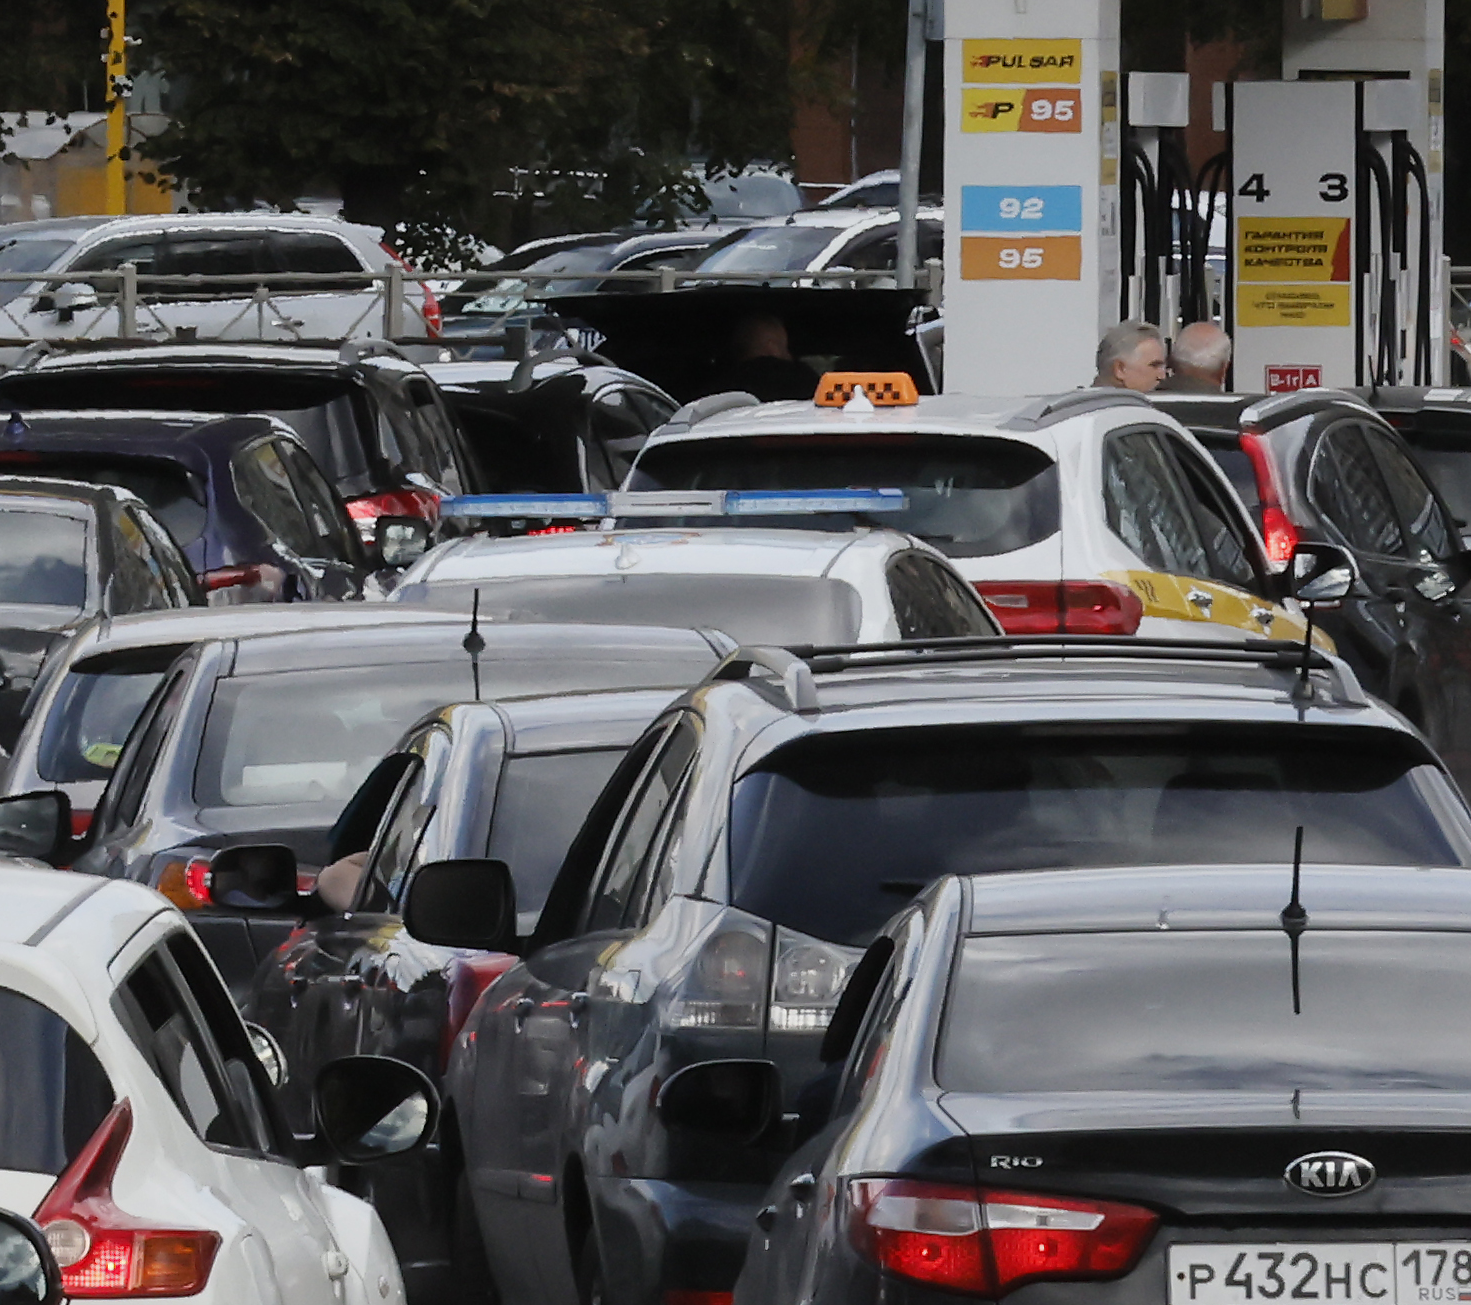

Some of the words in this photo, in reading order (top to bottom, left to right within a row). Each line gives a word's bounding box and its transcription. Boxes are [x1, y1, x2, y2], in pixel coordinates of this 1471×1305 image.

[987, 55, 1075, 69] PULSAR
[1031, 99, 1075, 121] 95
[1238, 173, 1271, 203] 4
[1318, 173, 1349, 203] 3
[999, 197, 1044, 219] 92
[998, 248, 1044, 268] 95
[990, 1155, 1044, 1169] RIO
[1300, 1161, 1362, 1188] KIA
[1189, 1251, 1388, 1300] Р432НС
[1419, 1287, 1457, 1300] RUS
